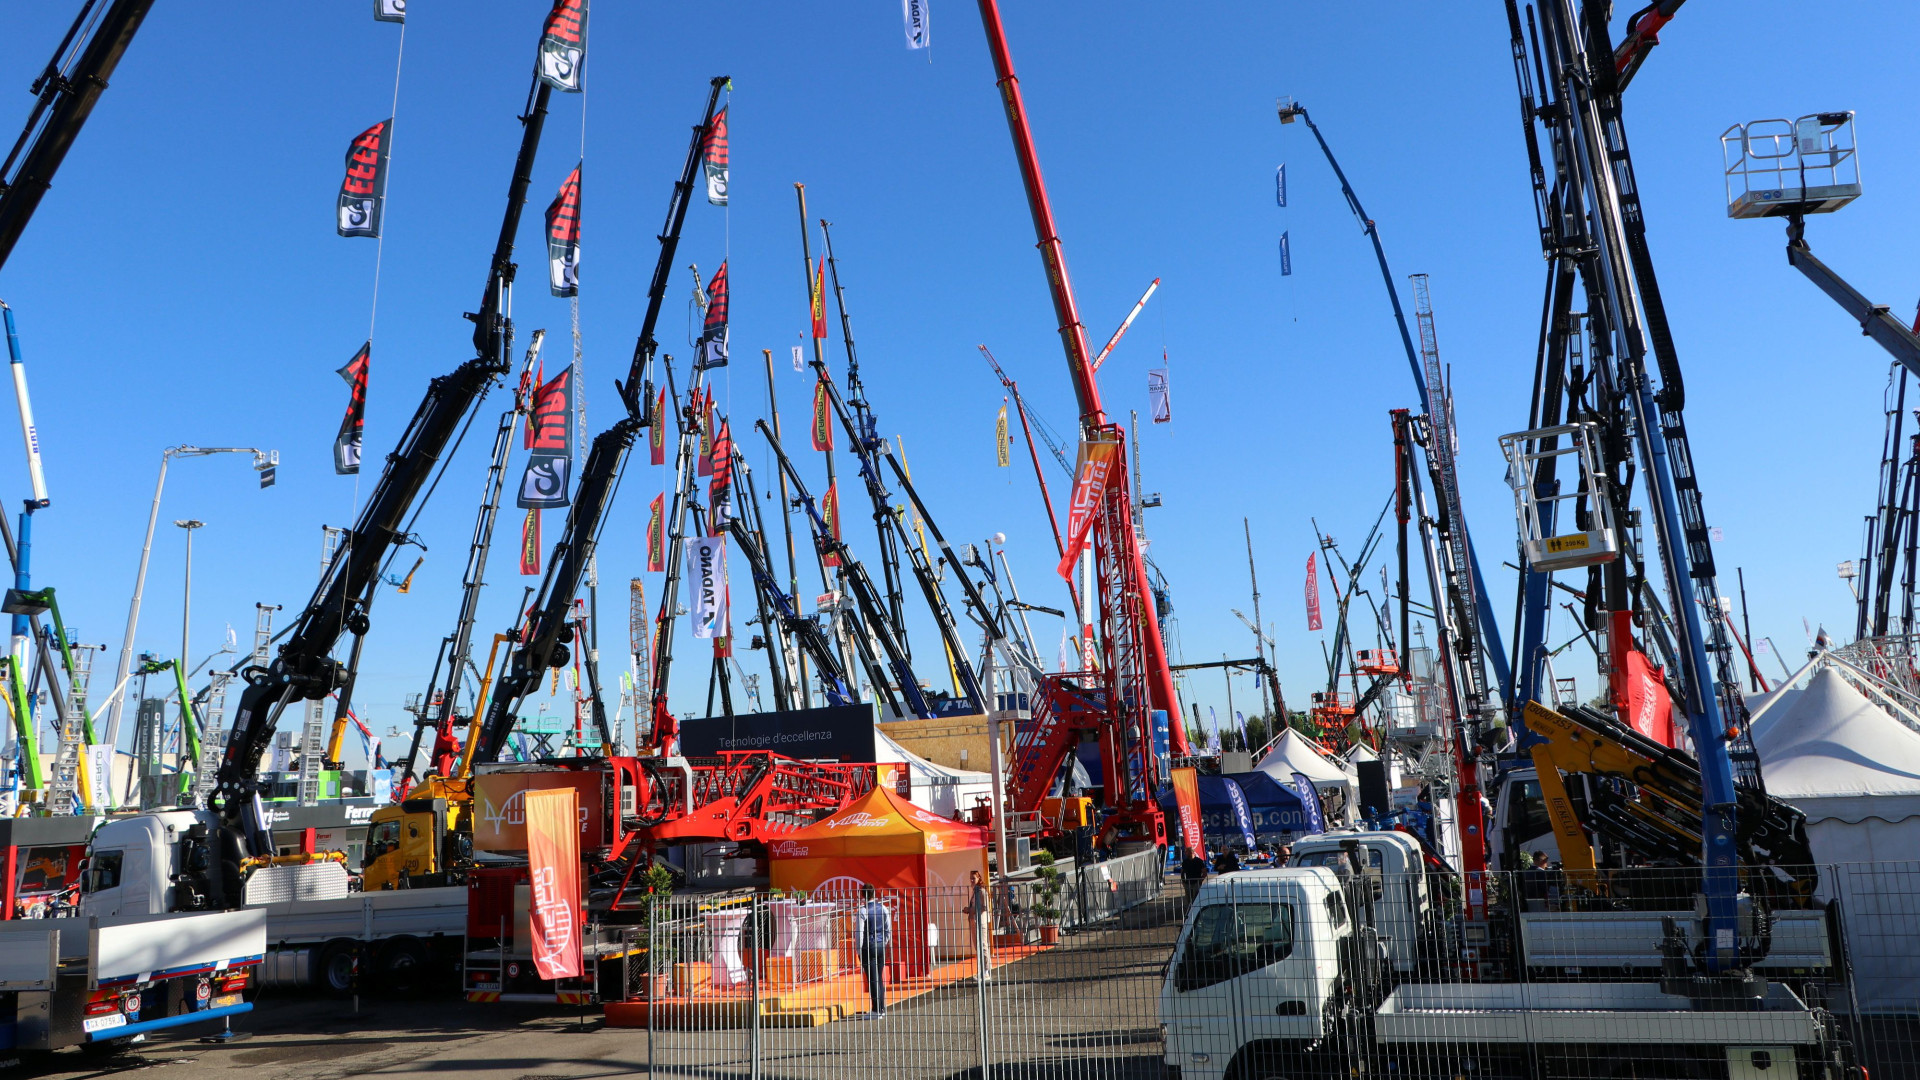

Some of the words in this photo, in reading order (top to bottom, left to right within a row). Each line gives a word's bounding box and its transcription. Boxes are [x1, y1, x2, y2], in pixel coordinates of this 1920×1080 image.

[1070, 461, 1095, 539] EICO
[1086, 460, 1108, 519] RIDGE
[719, 734, 771, 748] Tecnologie
[772, 730, 832, 744] d'eccellenza
[130, 999, 137, 1007] 70
